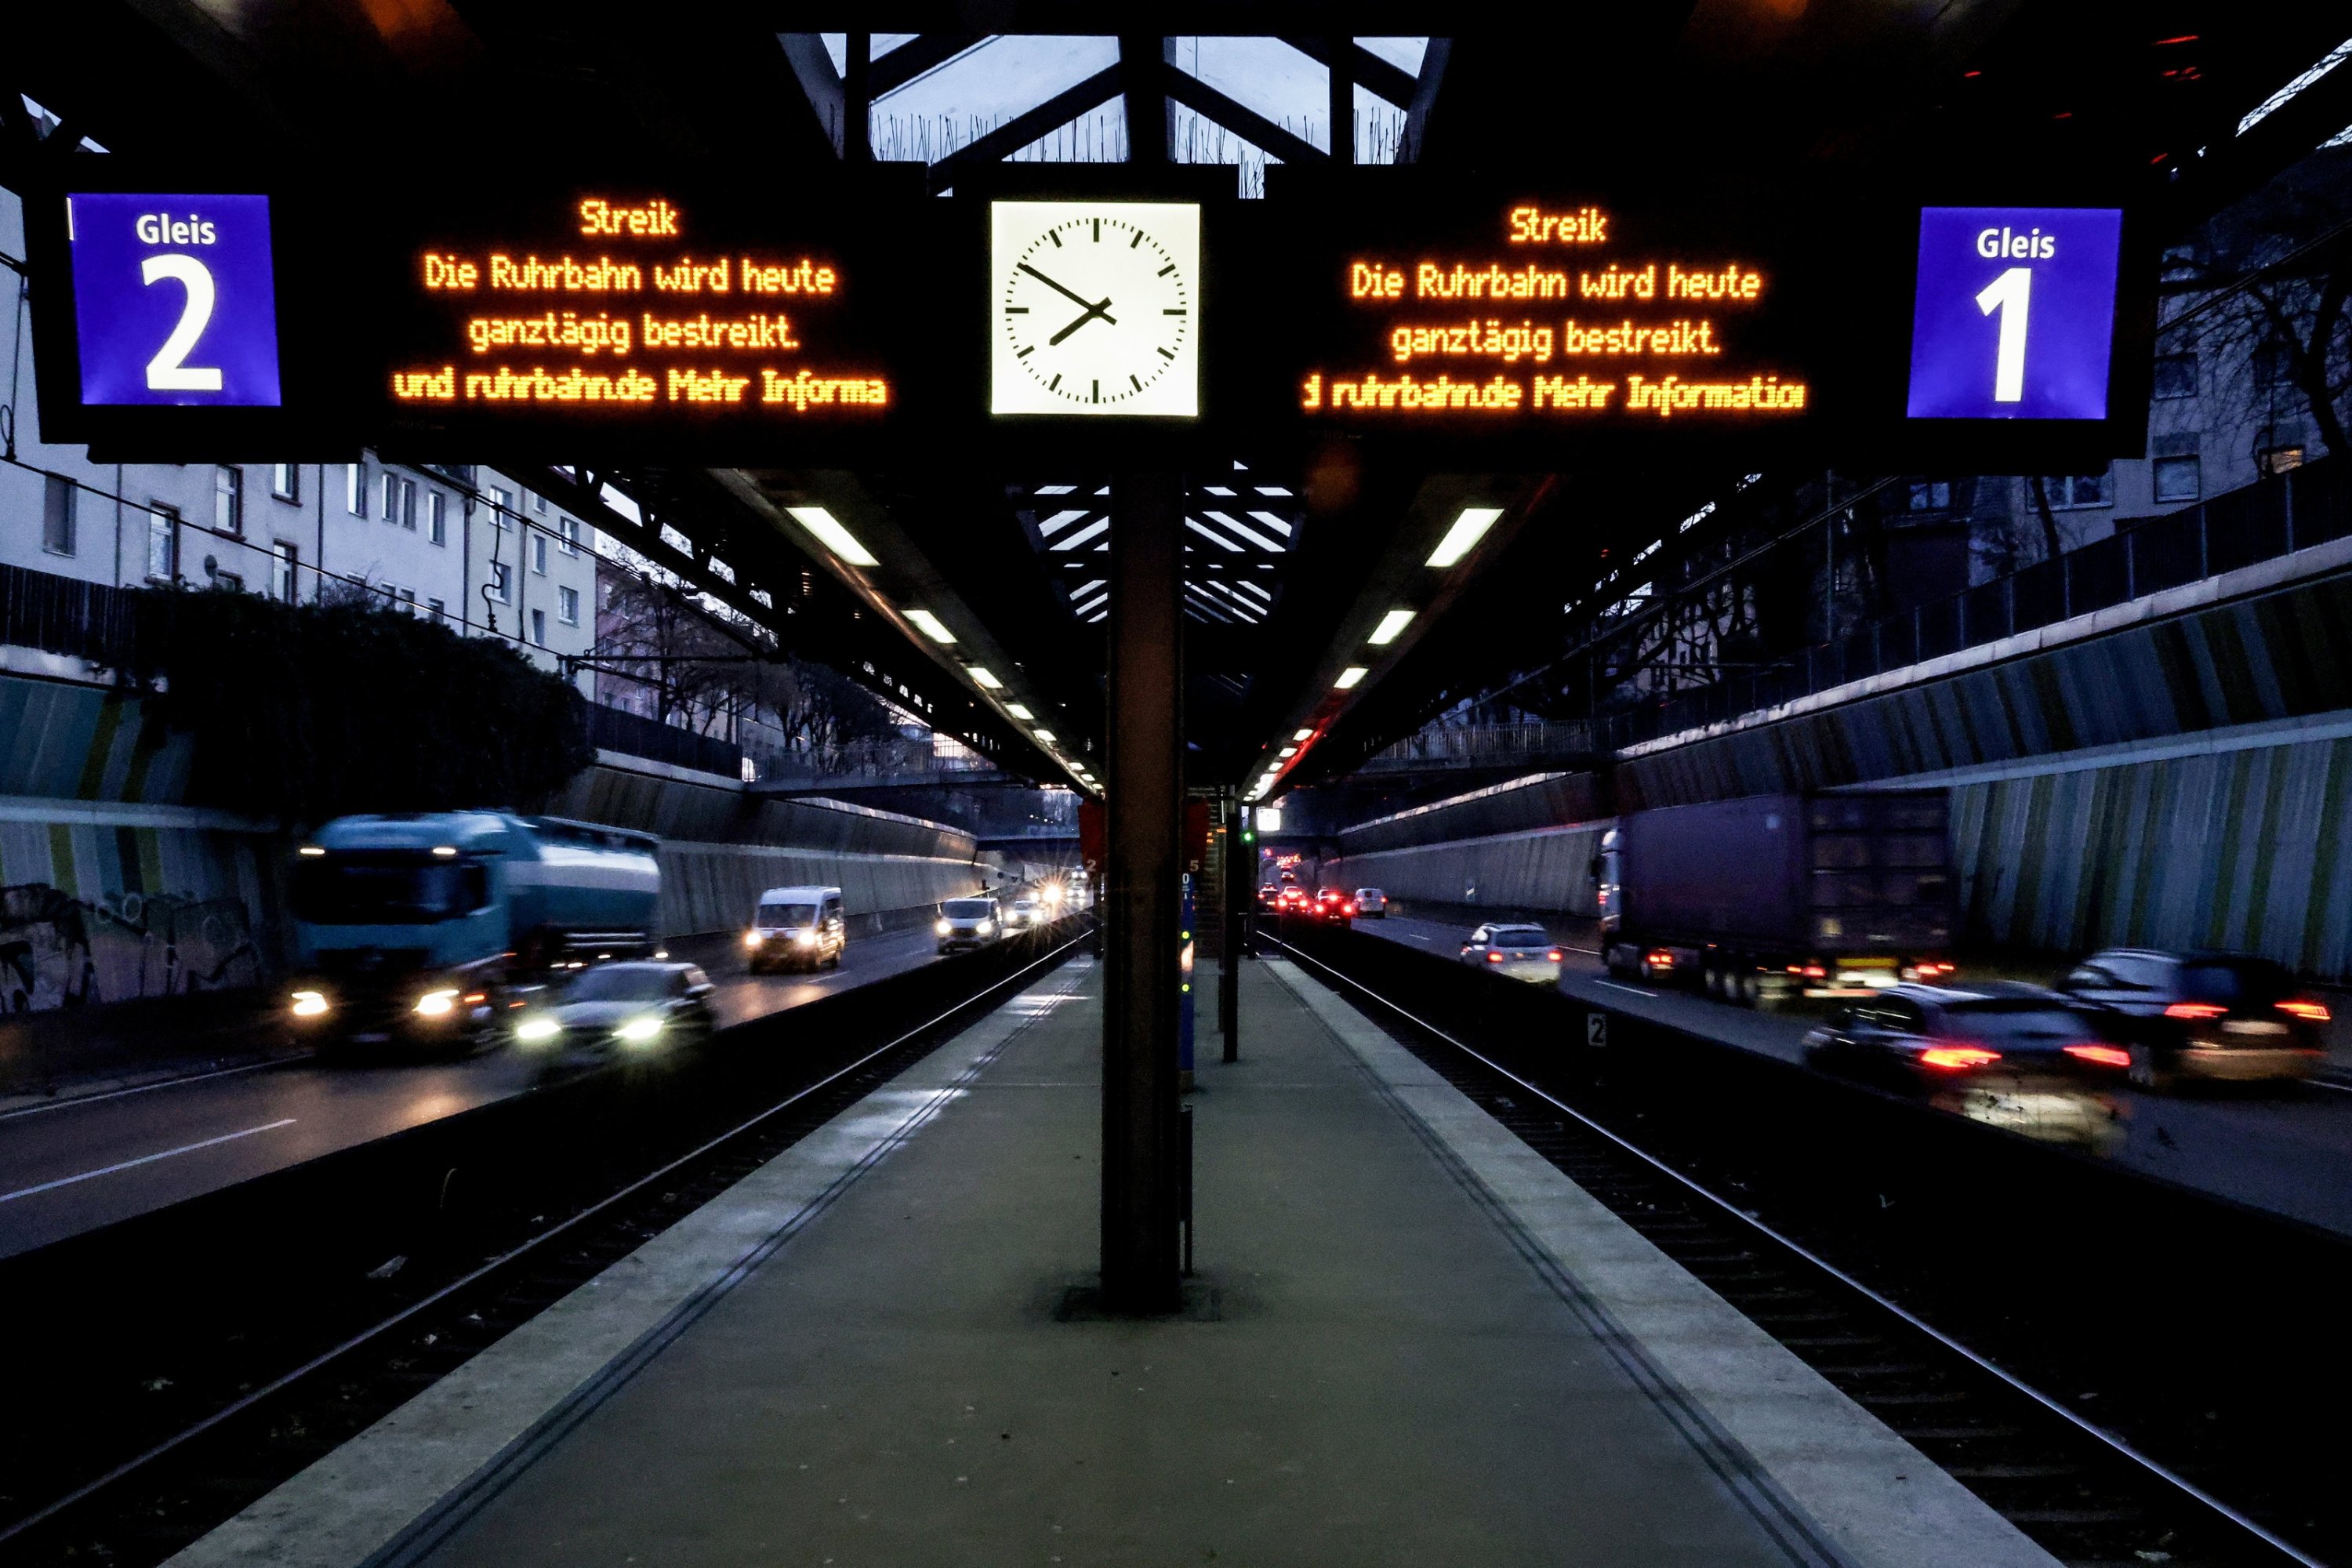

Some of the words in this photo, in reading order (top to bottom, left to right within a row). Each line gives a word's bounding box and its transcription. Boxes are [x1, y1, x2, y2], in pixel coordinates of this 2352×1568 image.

[136, 213, 216, 245] Gleis
[580, 200, 677, 234] Streik
[1510, 208, 1606, 241] Streik
[1976, 227, 2055, 259] Gleis
[425, 254, 477, 289] Die
[491, 255, 641, 290] Ruhrbahn
[655, 258, 728, 292] wird
[742, 259, 835, 293] heute
[1352, 263, 1404, 297] Die
[1417, 263, 1566, 298] Ruhrbahn
[1581, 264, 1655, 298] wird
[1668, 265, 1761, 298] heute
[141, 253, 223, 390] 2
[469, 312, 630, 354] ganztägig
[643, 313, 798, 348] bestreikt.
[1975, 267, 2032, 402] 1
[1392, 320, 1552, 361] ganztägig
[1566, 320, 1719, 354] bestreikt.
[394, 366, 455, 398] und
[668, 368, 750, 402] Mehr
[1534, 376, 1616, 408] Mehr
[1592, 1018, 1604, 1044] 2
